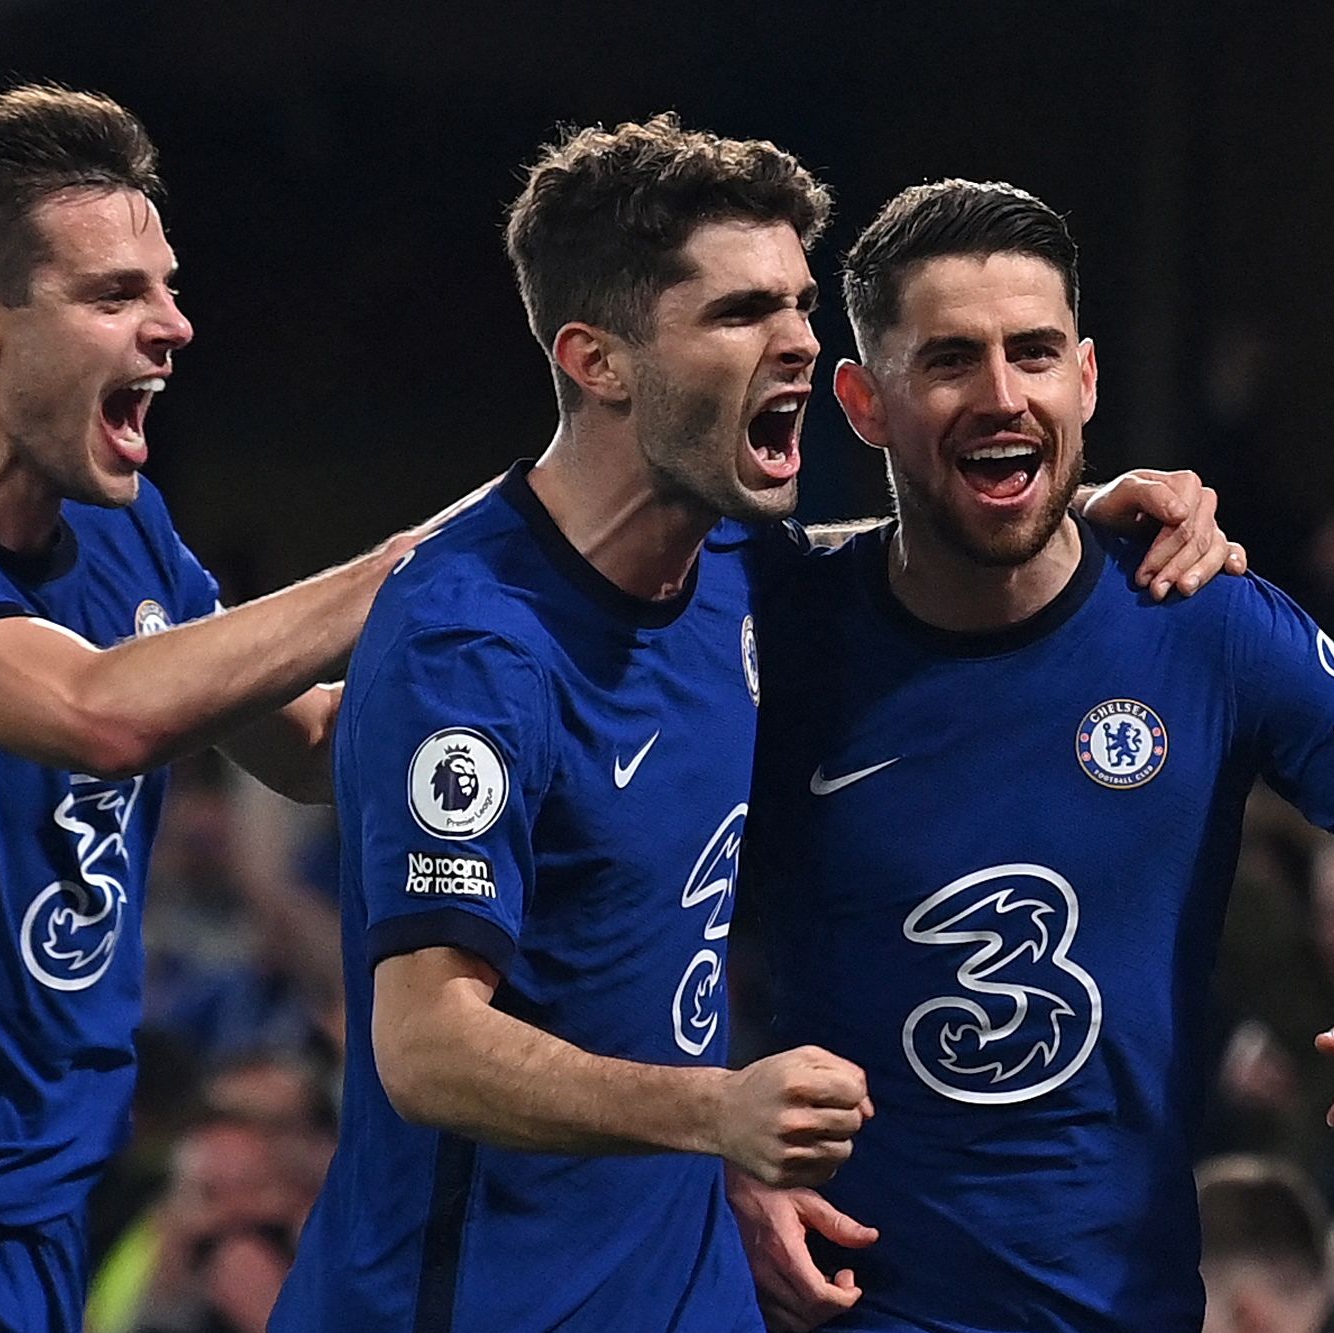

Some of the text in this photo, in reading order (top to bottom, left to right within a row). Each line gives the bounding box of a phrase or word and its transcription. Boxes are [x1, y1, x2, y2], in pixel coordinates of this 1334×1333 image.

[1089, 702, 1148, 723] CHELSEA
[1093, 765, 1154, 784] FOOTBALL CLUB
[446, 787, 494, 827] Premier League
[408, 853, 488, 879] No room
[405, 872, 496, 899] for racism
[903, 863, 1102, 1104] 3
